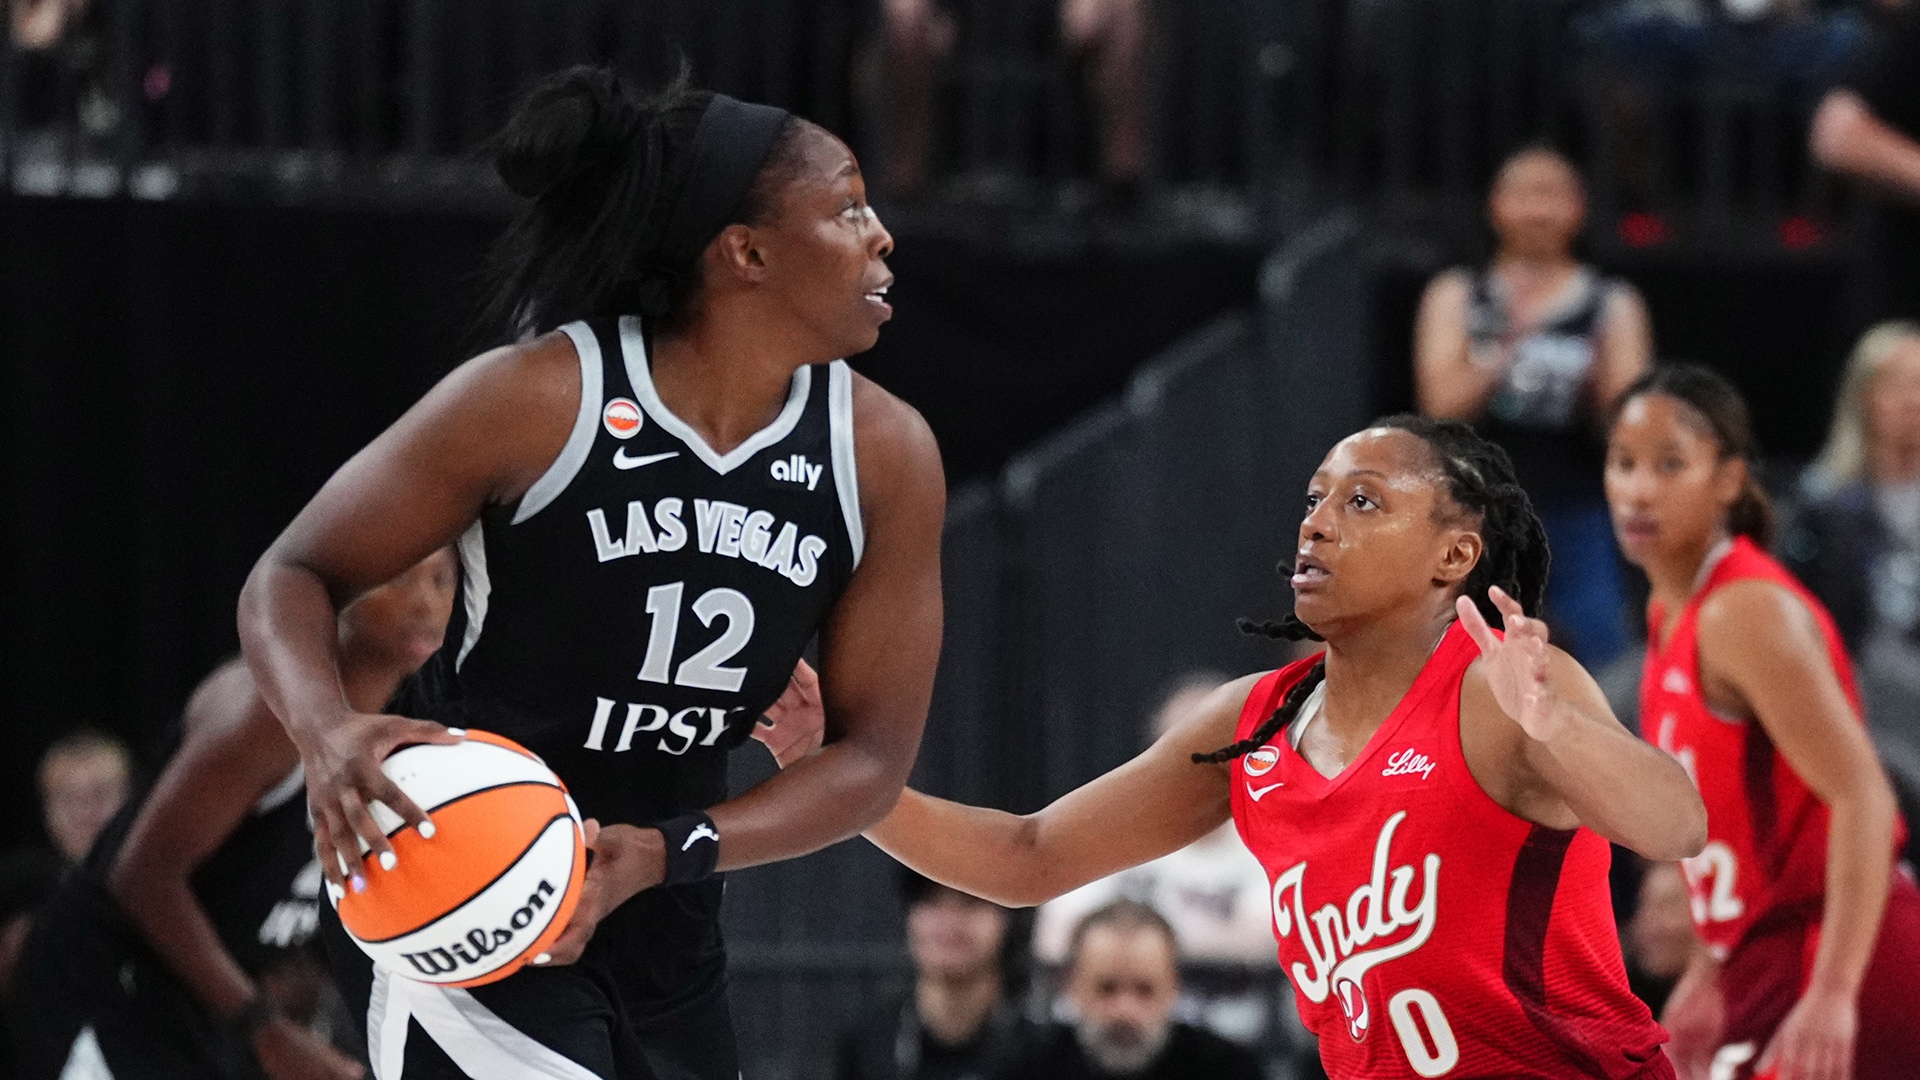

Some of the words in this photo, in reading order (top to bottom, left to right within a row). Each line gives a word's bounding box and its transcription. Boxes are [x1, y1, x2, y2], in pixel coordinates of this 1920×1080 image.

[770, 454, 823, 491] ally
[586, 497, 688, 562] LAS
[693, 498, 828, 588] VEGAS
[637, 580, 756, 692] 12
[583, 696, 746, 755] IPSY
[1382, 748, 1436, 780] Lilly
[400, 877, 557, 976] Wilson
[1273, 810, 1441, 1005] Indy
[1388, 988, 1459, 1078] 0
